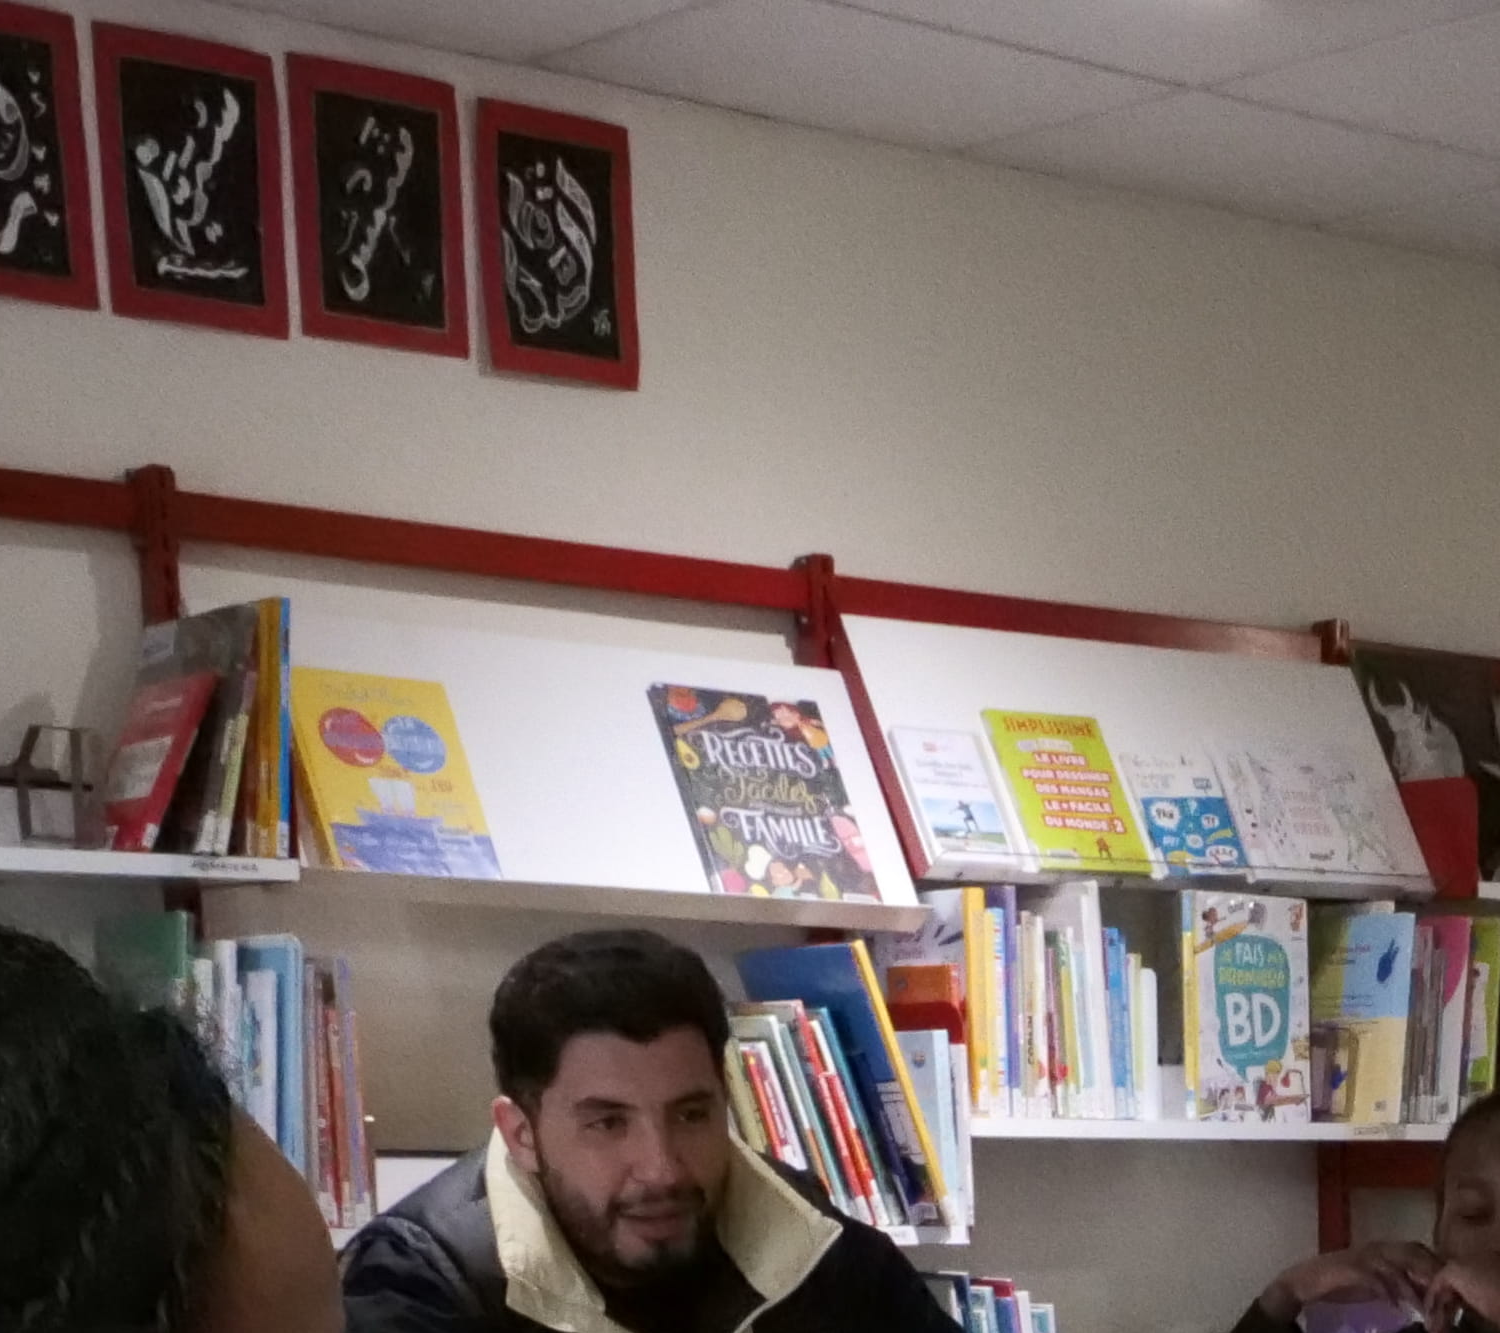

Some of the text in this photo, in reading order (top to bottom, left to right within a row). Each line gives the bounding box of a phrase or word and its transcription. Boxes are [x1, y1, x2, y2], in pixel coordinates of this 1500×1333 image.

[688, 727, 817, 779] RECETTES
[1060, 785, 1111, 798] MANGAS
[1070, 802, 1113, 814] FACILE
[720, 806, 842, 860] FAMILLE
[1065, 817, 1110, 832] MONDE
[1235, 941, 1266, 967] FAIS
[1224, 991, 1282, 1049] BD
